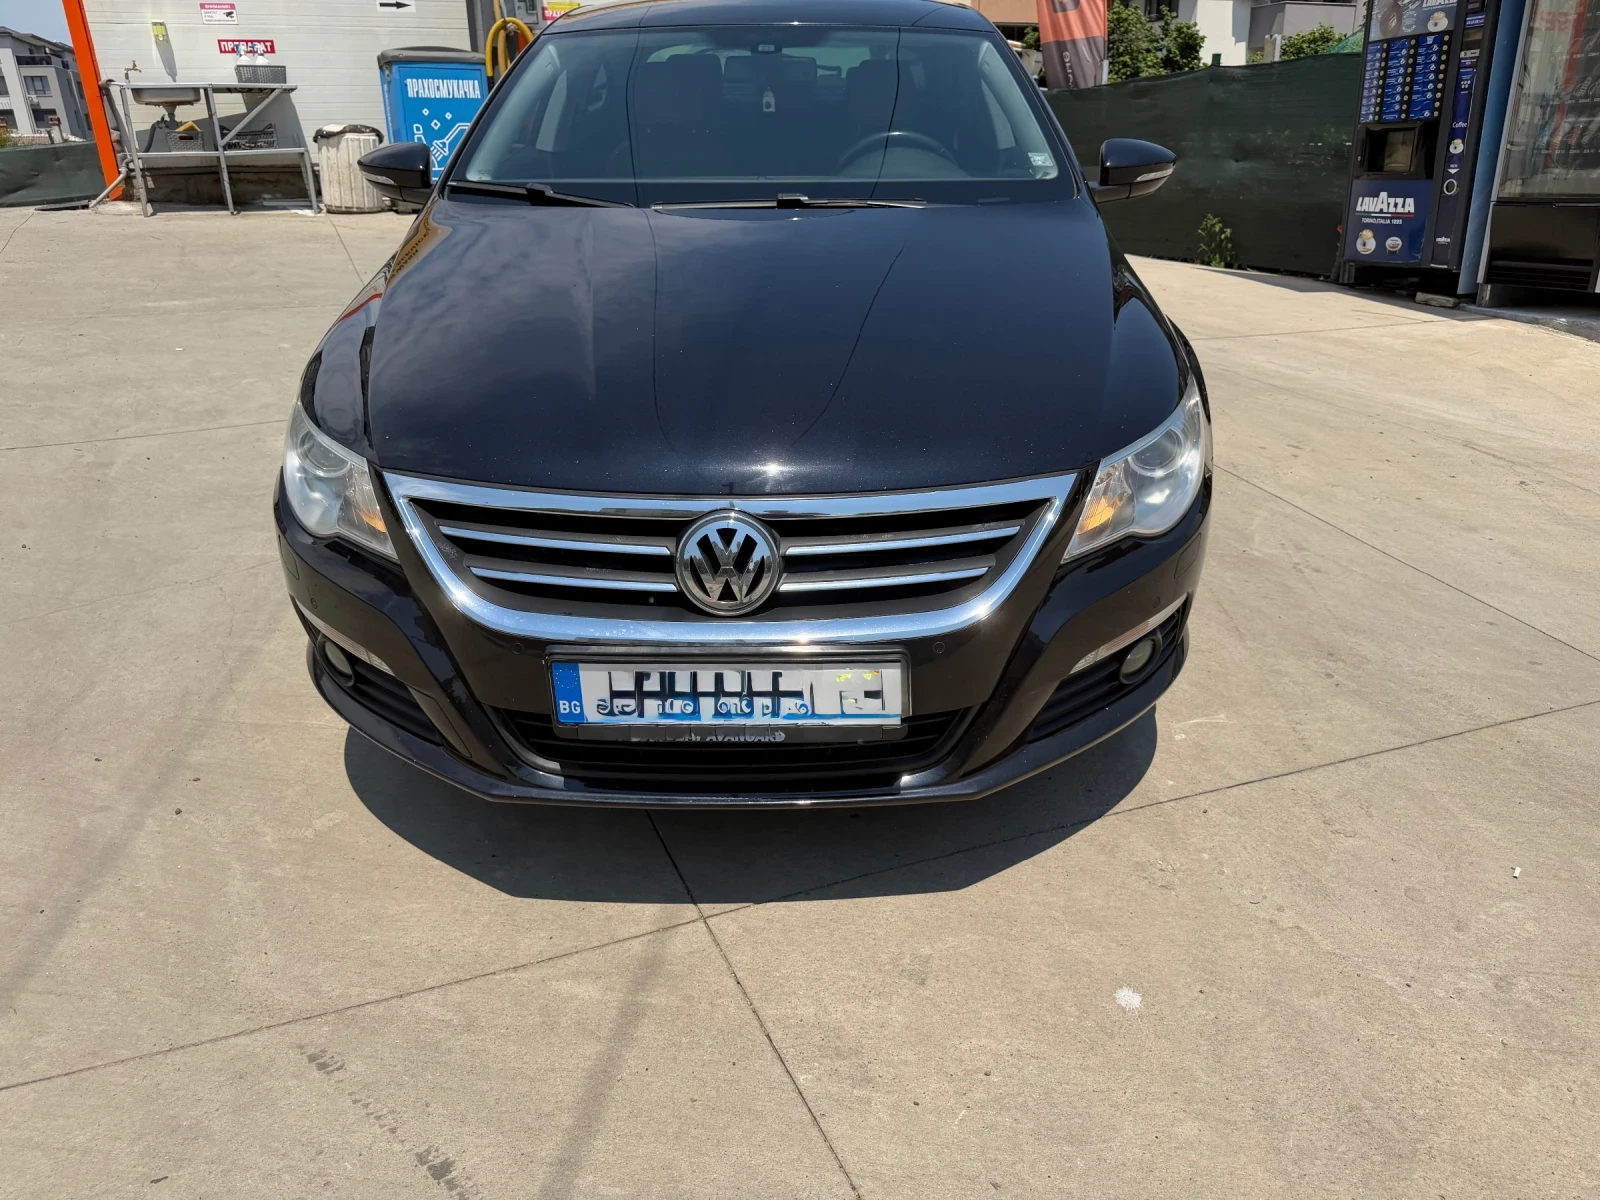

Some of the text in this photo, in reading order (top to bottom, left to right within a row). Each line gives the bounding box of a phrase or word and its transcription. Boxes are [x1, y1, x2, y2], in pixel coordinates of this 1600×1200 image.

[406, 79, 481, 99] ПРАХОСМУКАЧКА
[1356, 192, 1415, 213] LAVAZZA
[559, 700, 581, 714] BG
